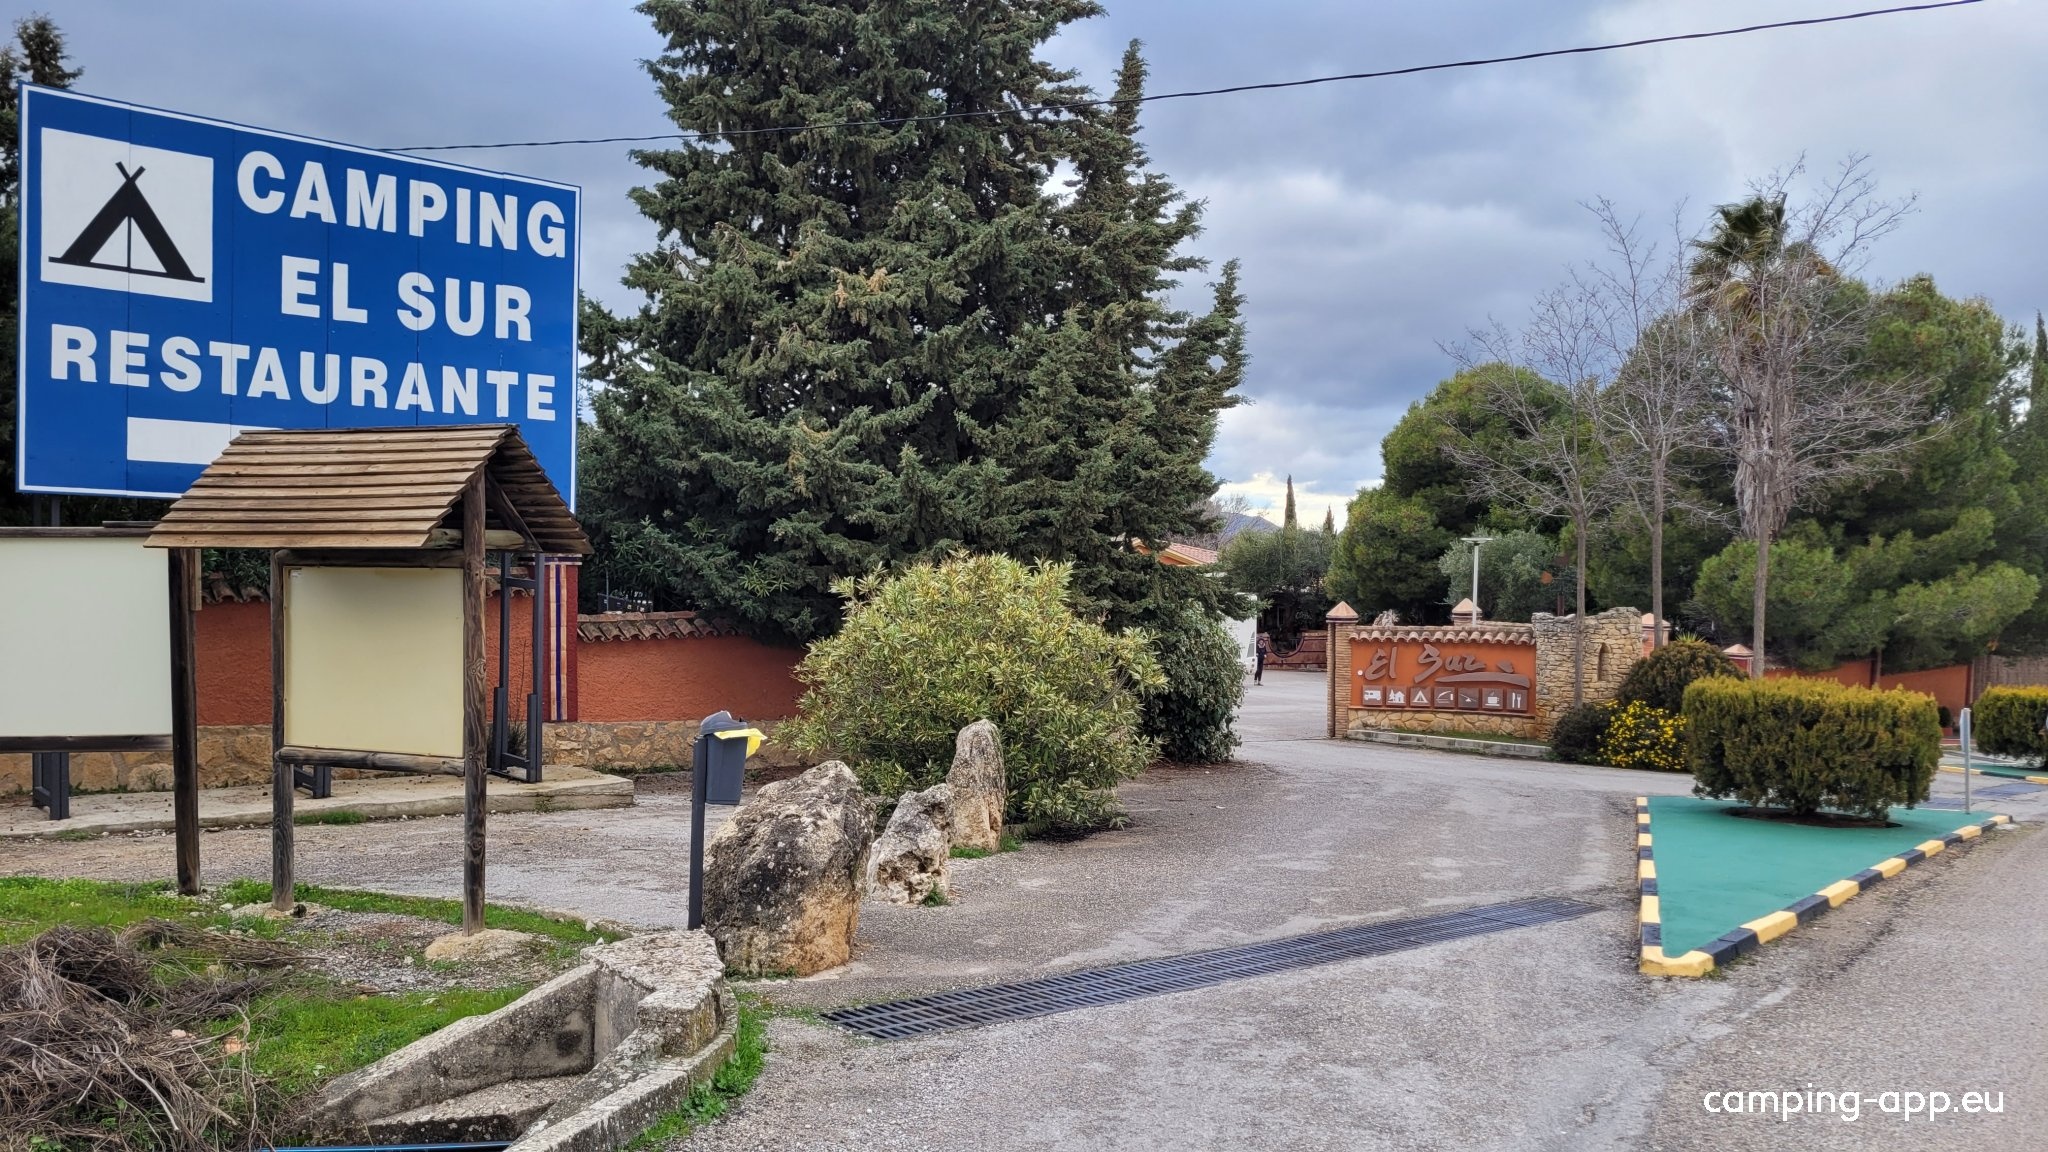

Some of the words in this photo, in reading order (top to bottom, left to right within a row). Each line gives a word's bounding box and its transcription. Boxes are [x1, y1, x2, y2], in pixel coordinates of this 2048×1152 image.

[237, 150, 566, 258] CAMPING
[281, 255, 368, 323] EL
[397, 271, 532, 341] SUR
[51, 324, 555, 421] RESTAURANTE
[1364, 646, 1397, 681] El
[1414, 644, 1486, 683] Sur
